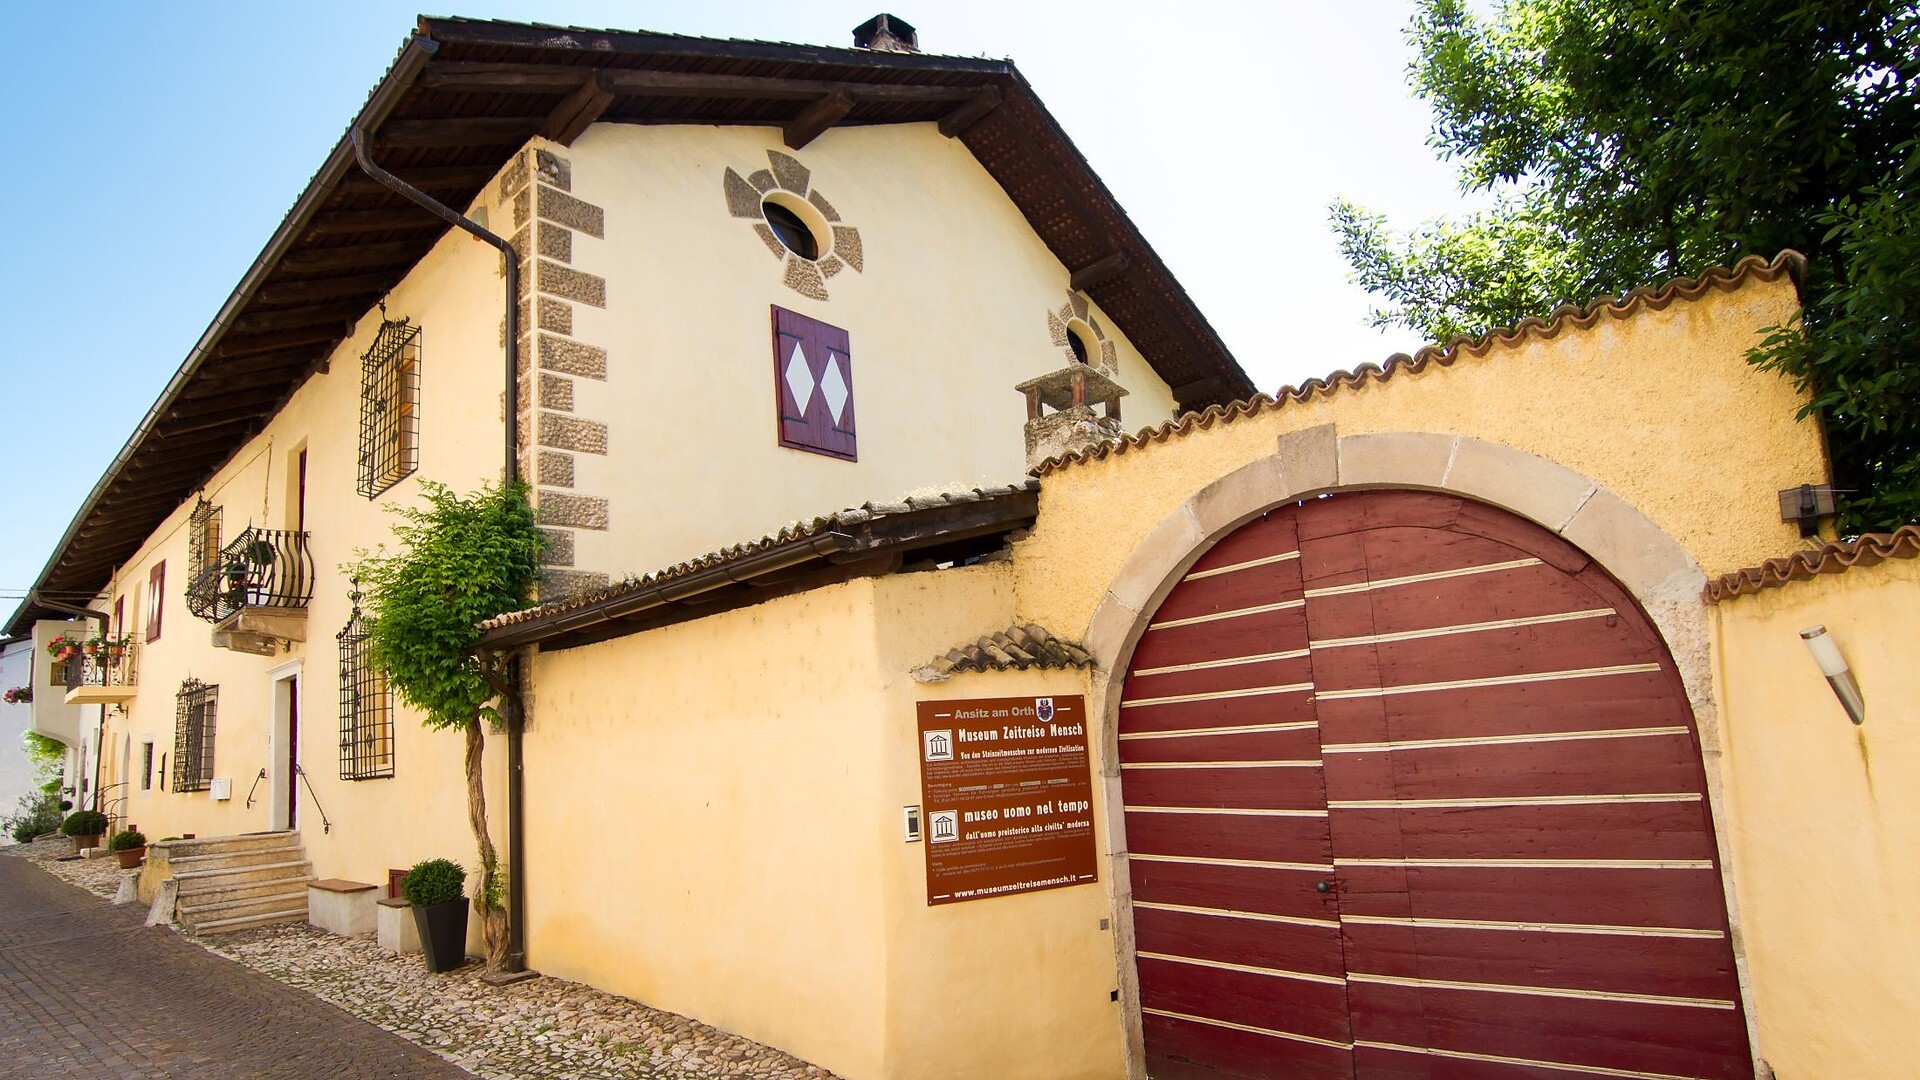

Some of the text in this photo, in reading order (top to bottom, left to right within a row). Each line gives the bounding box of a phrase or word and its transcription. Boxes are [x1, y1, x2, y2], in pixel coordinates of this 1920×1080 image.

[955, 706, 1035, 719] Ansitz am Orth
[959, 723, 1083, 742] Museum Zeitreise Mensch
[961, 751, 971, 759] Von
[1059, 745, 1084, 753] Zivilisation
[964, 800, 1089, 823] museo uomo nel tempo
[966, 830, 996, 840] dall'uomo
[998, 827, 1029, 838] preistorico
[1031, 825, 1043, 833] alla
[1067, 820, 1090, 829] moderna
[954, 875, 1076, 898] www.museumzeitreisemensch.it
